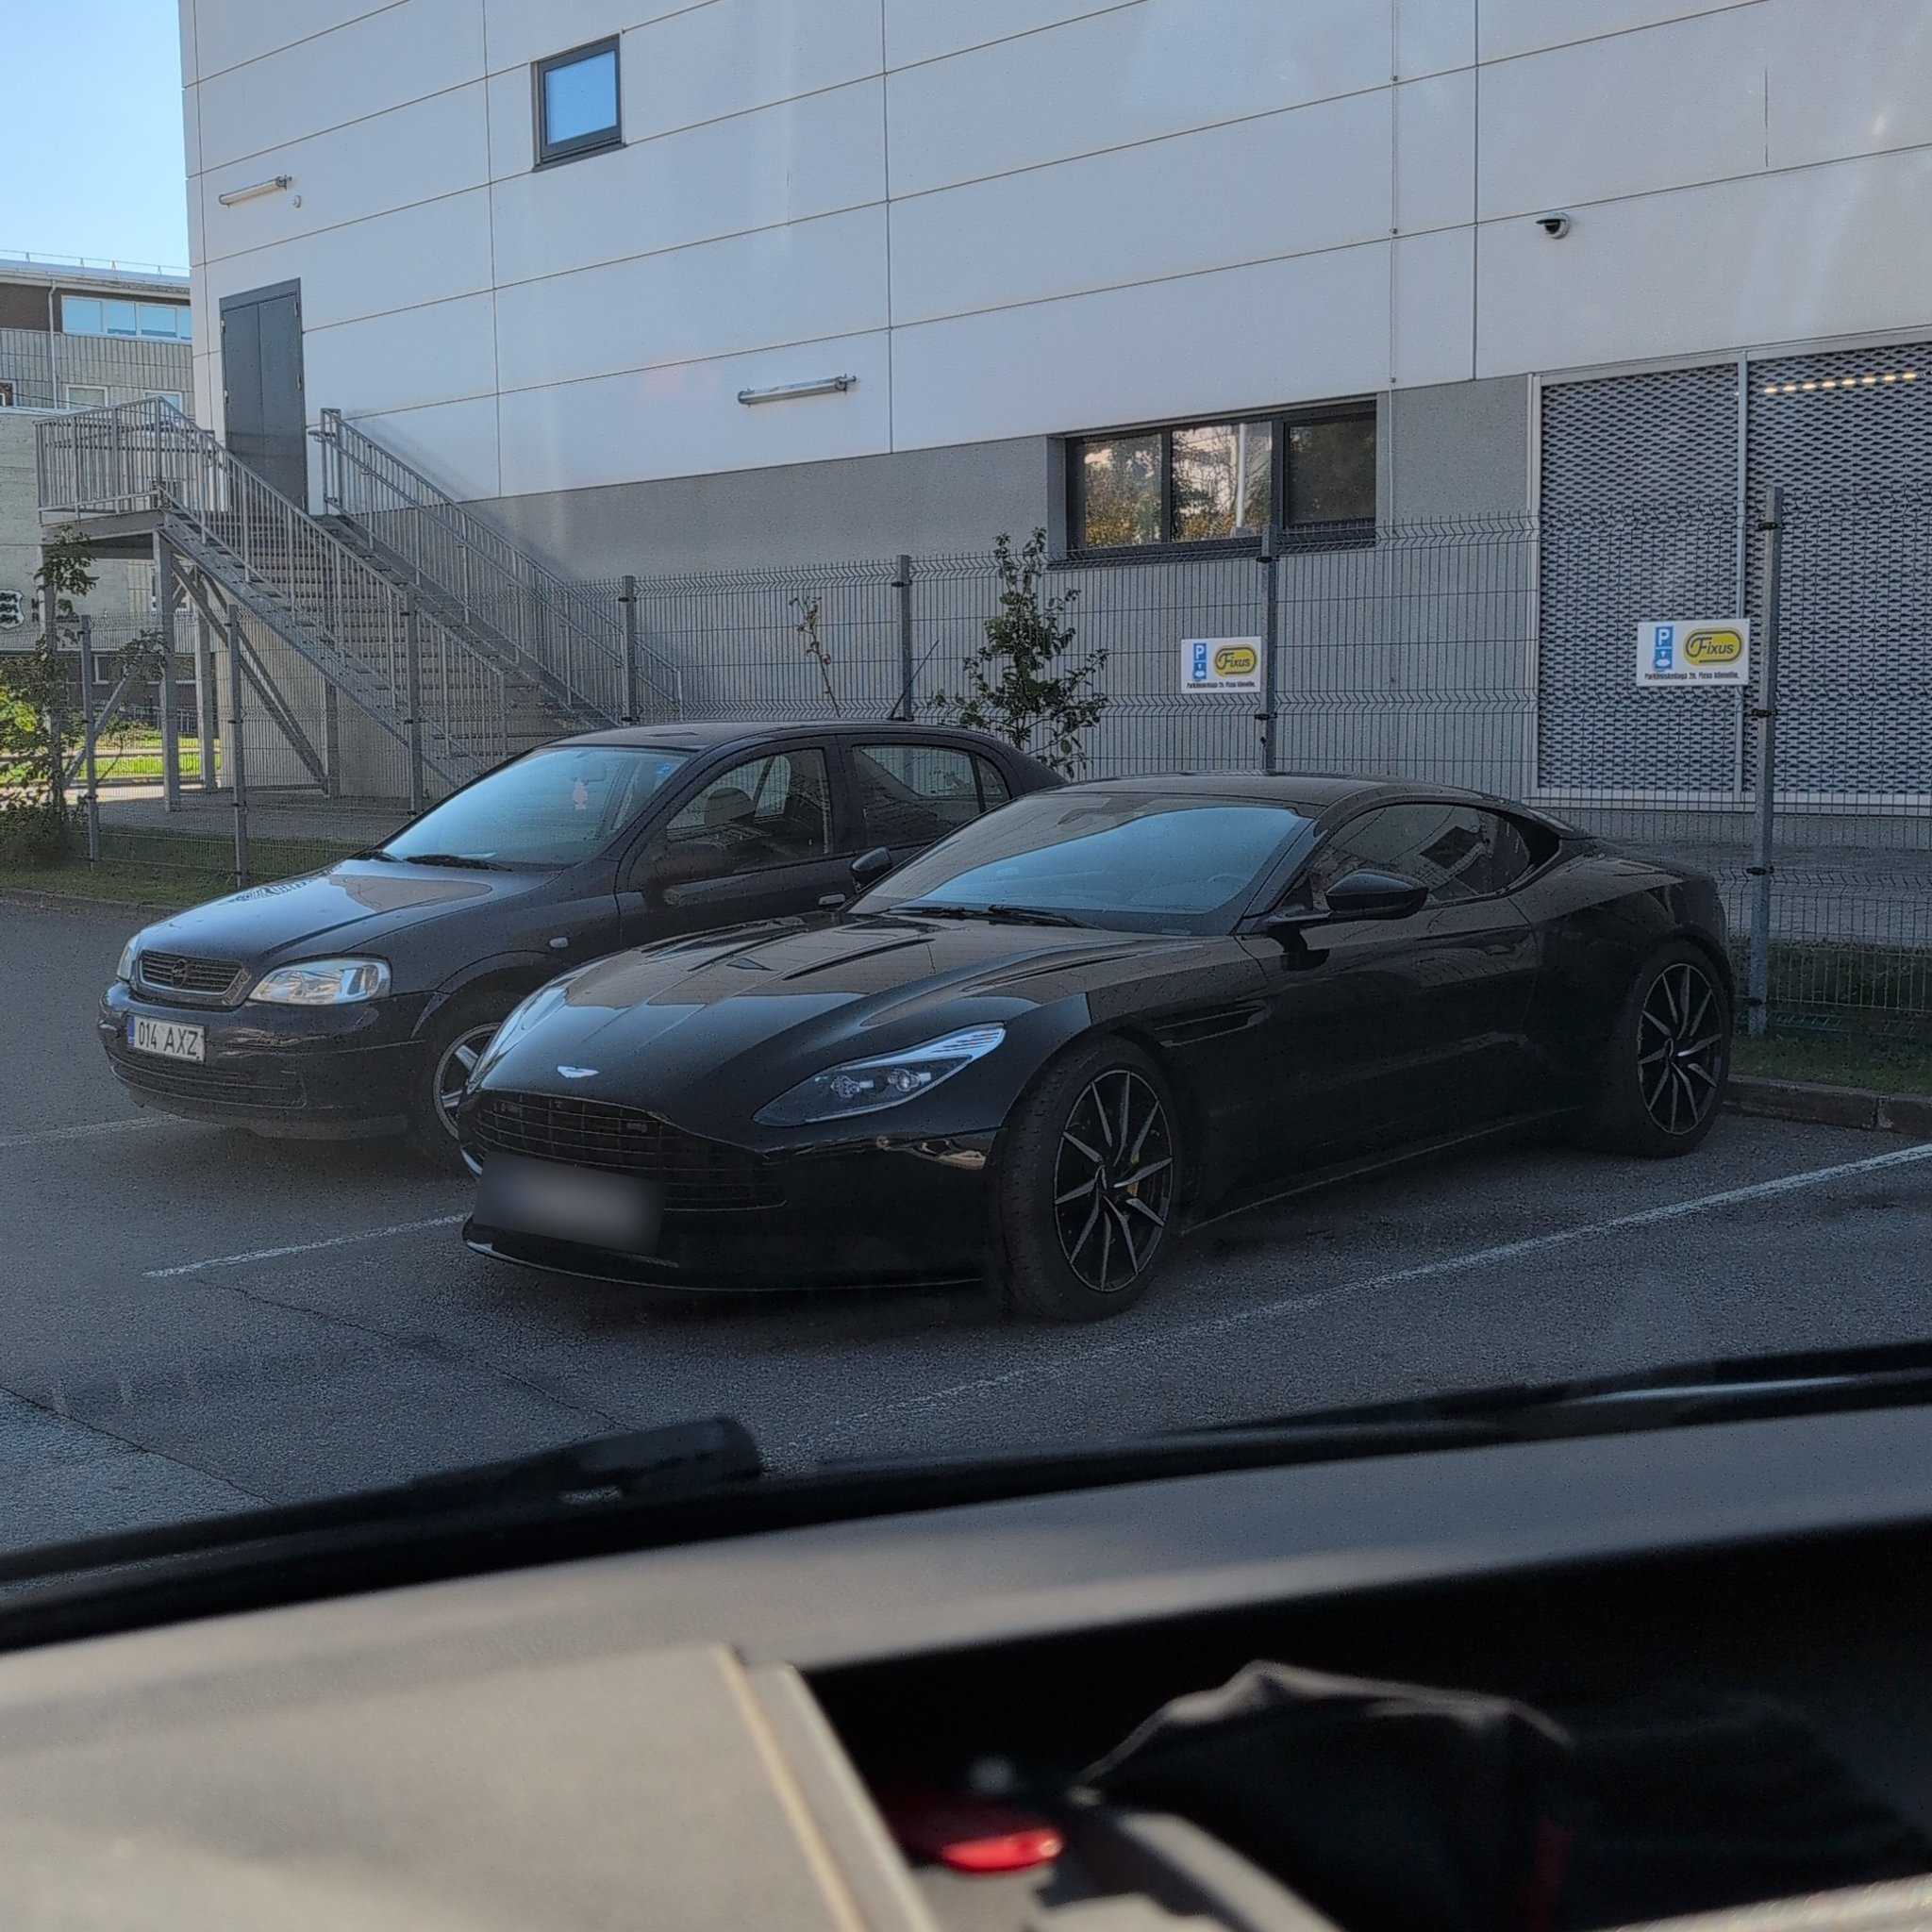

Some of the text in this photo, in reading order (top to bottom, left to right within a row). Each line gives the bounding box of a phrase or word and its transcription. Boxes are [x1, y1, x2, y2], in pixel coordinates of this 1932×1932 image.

[1658, 628, 1670, 645] P
[1195, 644, 1205, 659] P
[1690, 636, 1734, 658] Fixus
[1218, 652, 1251, 670] Fixus
[139, 1022, 198, 1056] 014 AXZ
